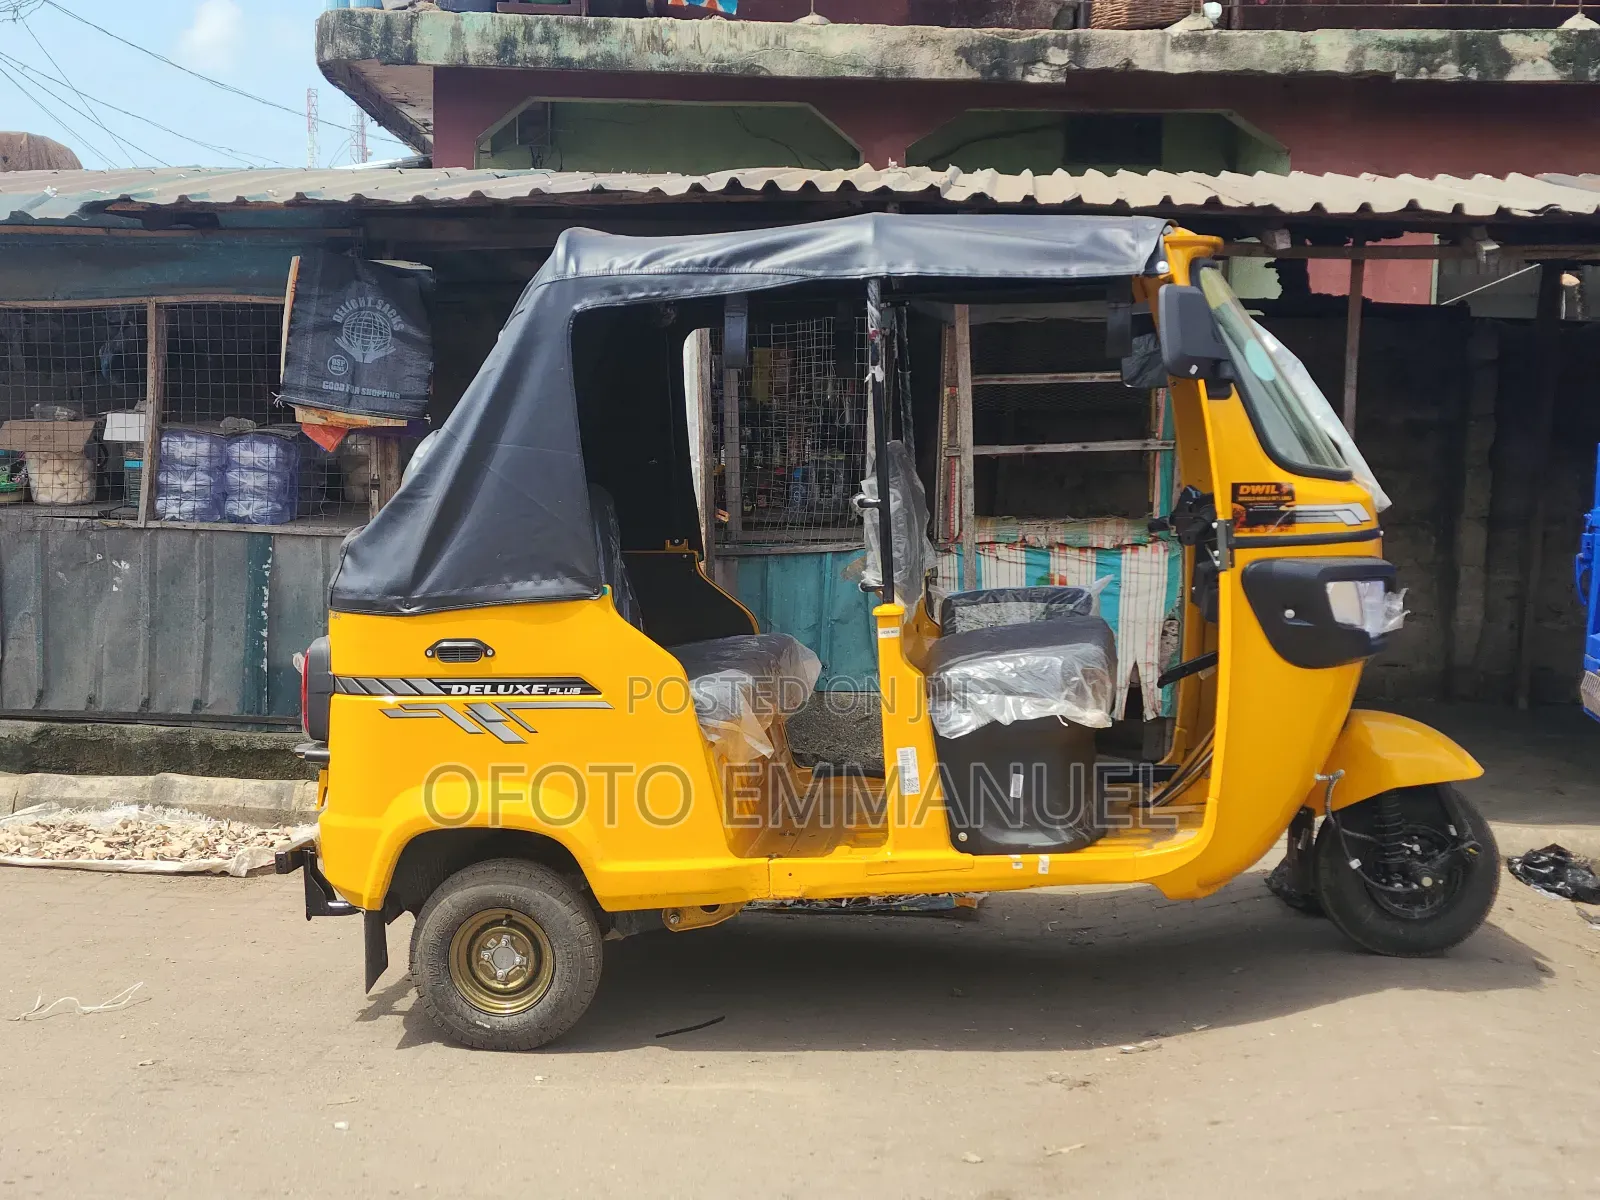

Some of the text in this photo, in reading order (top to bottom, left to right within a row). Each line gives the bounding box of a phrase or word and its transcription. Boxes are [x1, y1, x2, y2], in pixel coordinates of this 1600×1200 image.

[332, 296, 405, 331] DELIGHT SACKS
[322, 381, 345, 392] GOOD
[361, 387, 401, 399] SHOPPING
[451, 684, 582, 695] DELUXE PLUS
